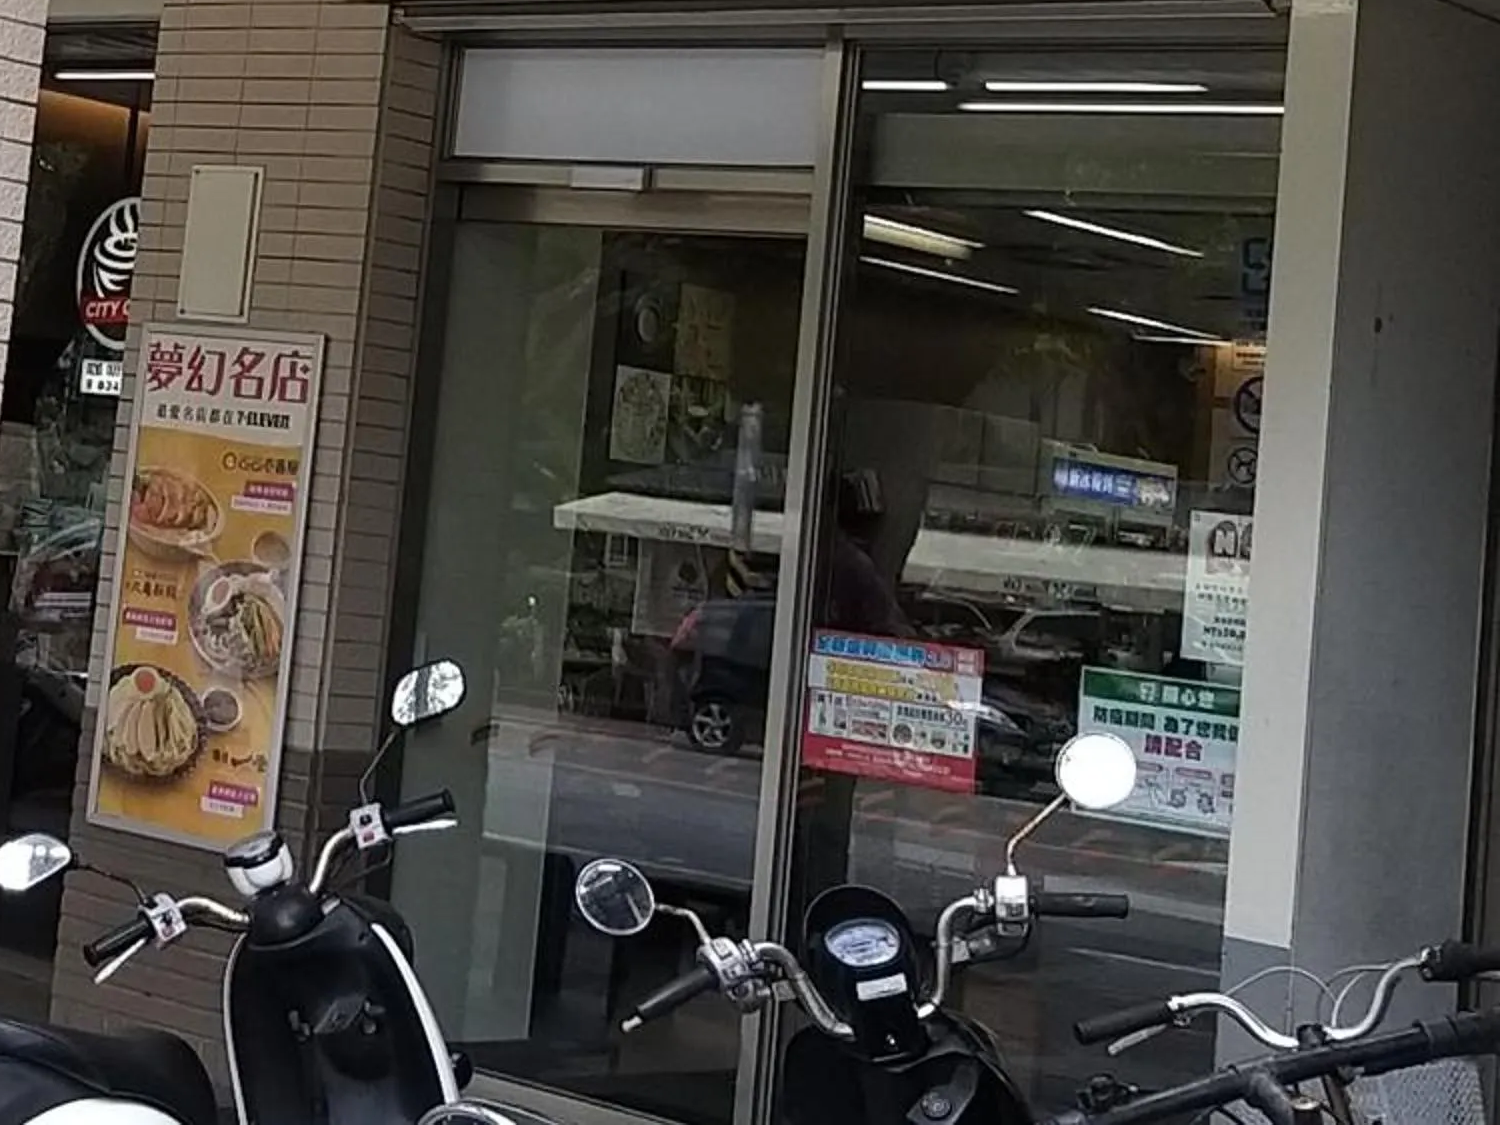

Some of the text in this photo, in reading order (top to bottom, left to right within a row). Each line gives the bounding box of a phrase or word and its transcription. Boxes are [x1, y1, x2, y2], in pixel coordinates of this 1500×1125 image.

[85, 299, 122, 319] CITY
[148, 340, 313, 404] 夢幻名店
[1144, 733, 1203, 761] 請配合
